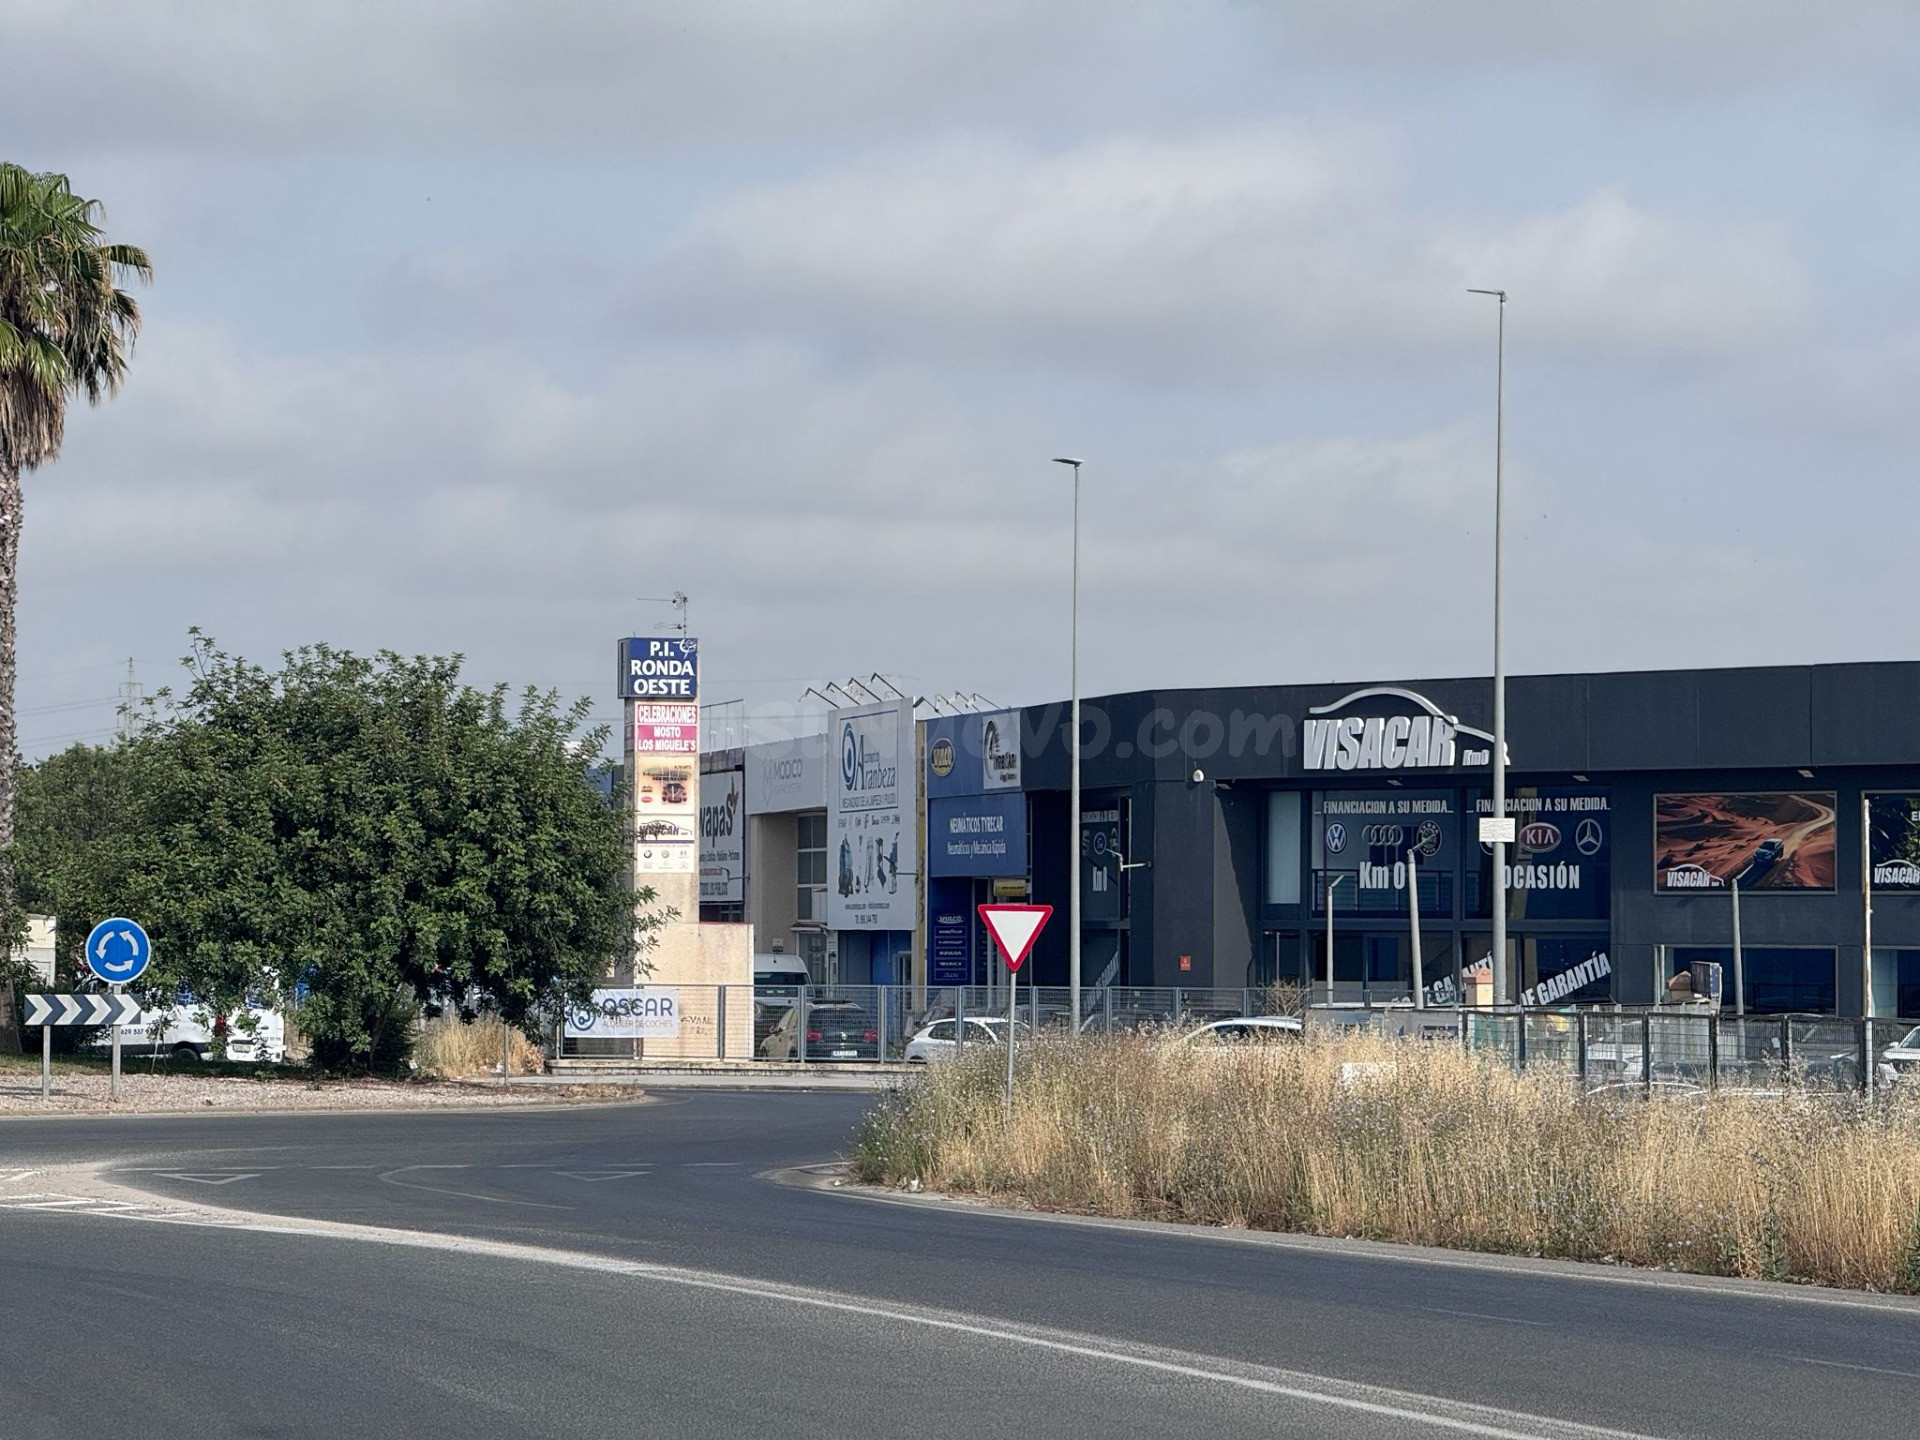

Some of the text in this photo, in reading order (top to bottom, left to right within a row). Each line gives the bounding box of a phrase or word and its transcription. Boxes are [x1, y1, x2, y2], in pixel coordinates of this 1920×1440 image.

[650, 641, 674, 656] P.I.
[630, 660, 695, 676] RONDA
[633, 679, 691, 695] OESTE
[639, 705, 696, 723] CELEBRACIONES
[653, 726, 681, 738] MOSTO
[638, 739, 696, 751] LOS MIGUELE'S
[1303, 715, 1459, 770] VISACAR
[1323, 800, 1386, 815] FINANCIACION
[1388, 800, 1395, 814] A
[1397, 800, 1410, 814] SU
[1476, 798, 1542, 813] FINCIACION
[1545, 797, 1553, 811] A
[1554, 797, 1568, 812] SU
[949, 811, 981, 833] NEUMÁTICOS
[1526, 828, 1554, 844] KIA
[1359, 862, 1389, 889] Km
[1503, 860, 1580, 889] OCASIÓN
[1667, 871, 1711, 887] VISACAR
[1536, 950, 1612, 1006] GARANTÍA
[602, 997, 673, 1017] OSCAR
[636, 1020, 644, 1028] DE
[644, 1020, 673, 1028] COCHES
